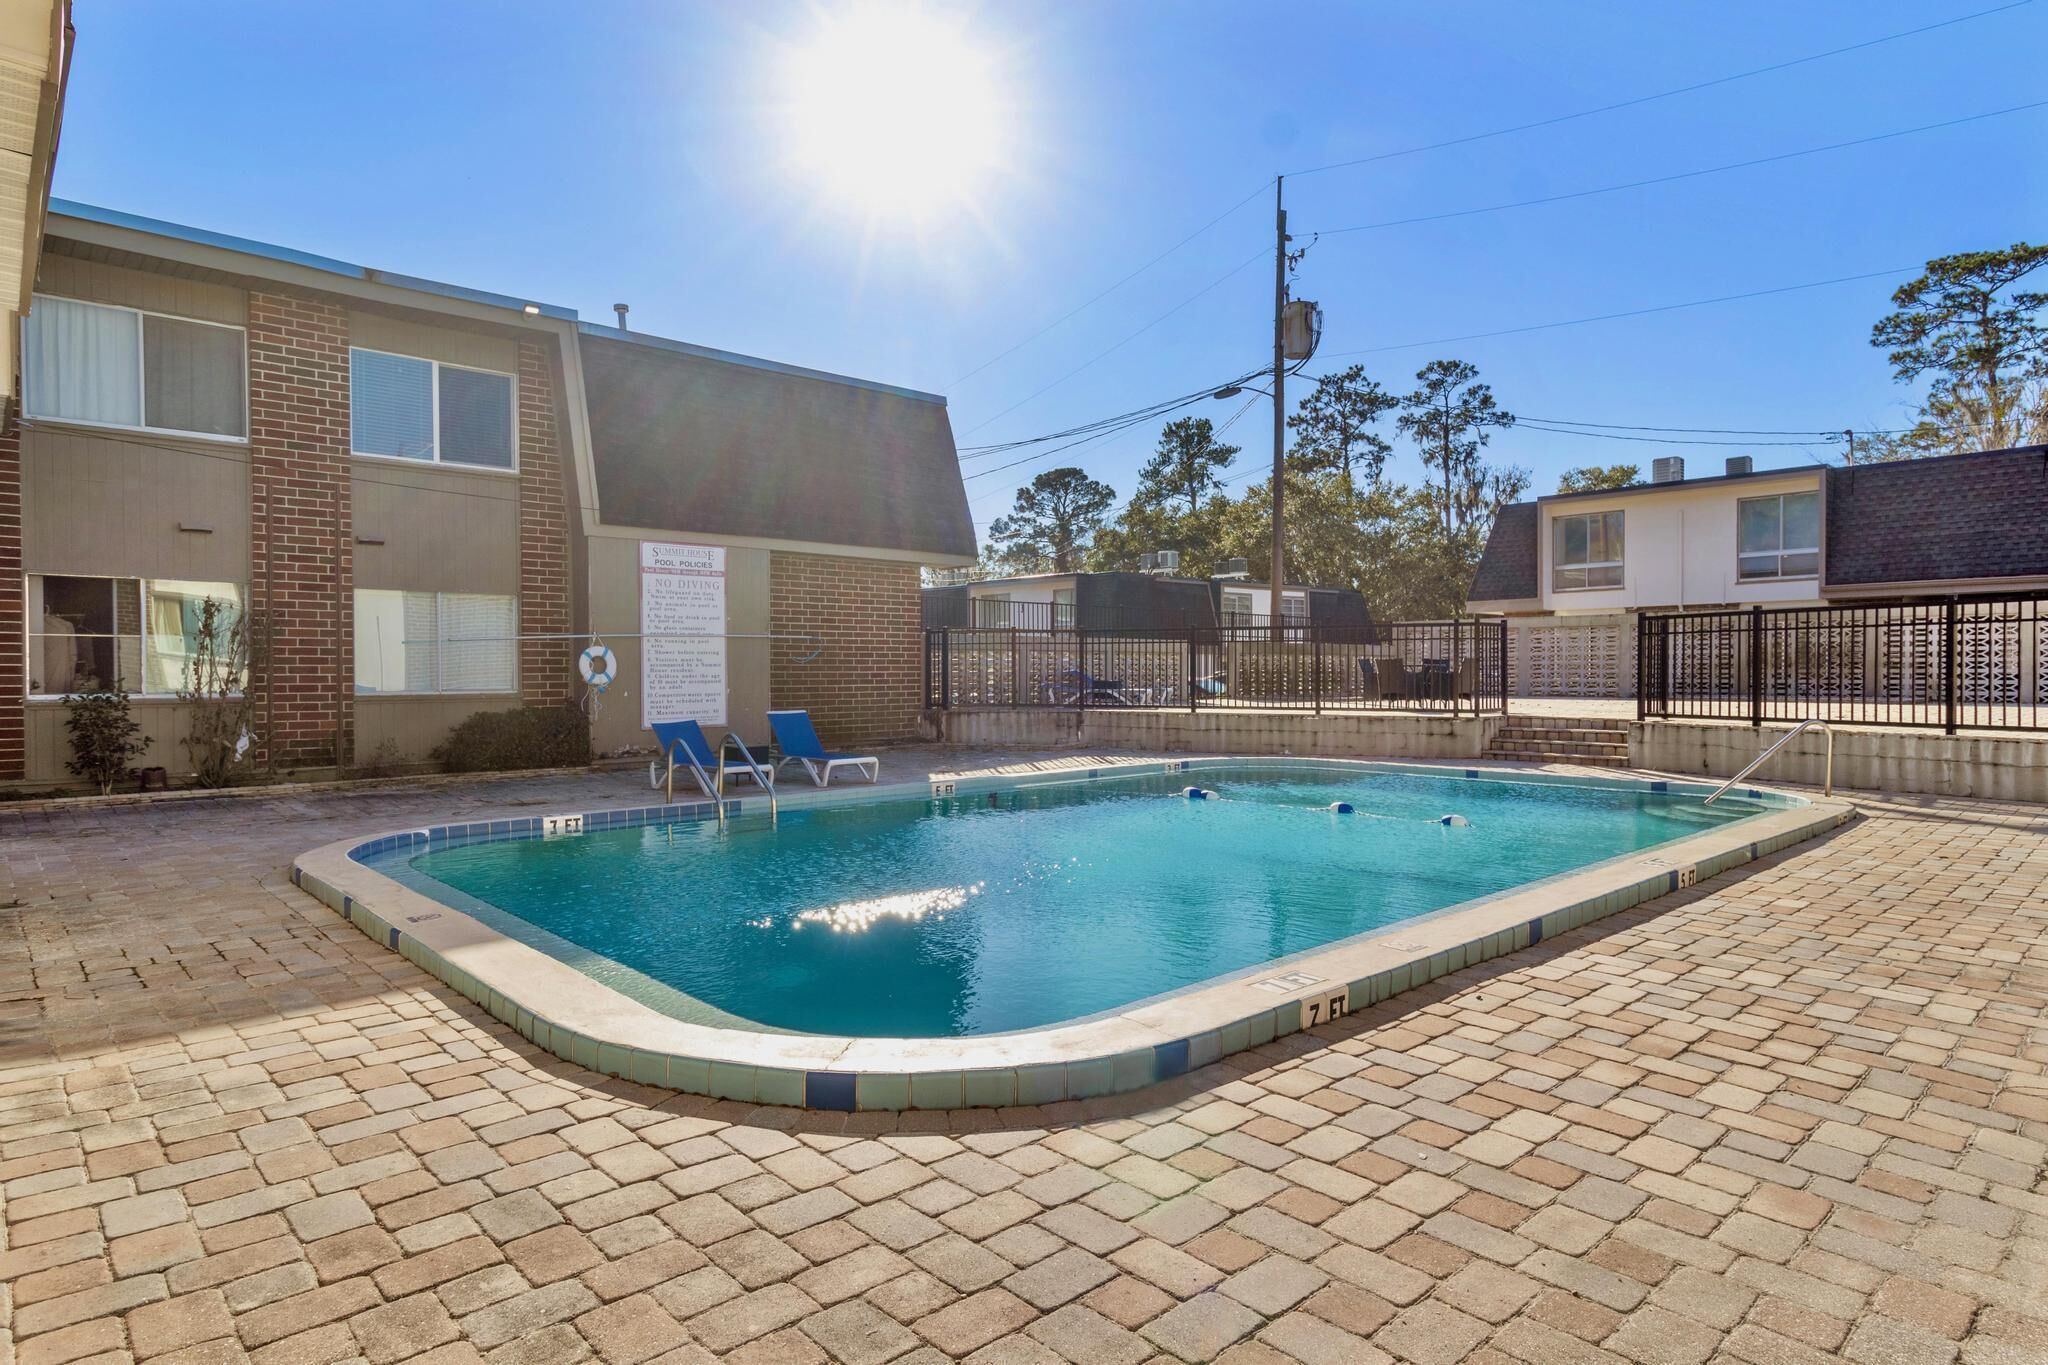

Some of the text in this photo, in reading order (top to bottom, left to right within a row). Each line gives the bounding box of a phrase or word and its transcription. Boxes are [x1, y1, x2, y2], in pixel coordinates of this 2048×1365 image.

[679, 560, 713, 568] POLICIES
[655, 579, 672, 588] NO
[678, 580, 720, 590] DIVING
[564, 818, 580, 828] FT
[1310, 994, 1346, 1027] 7 FT
